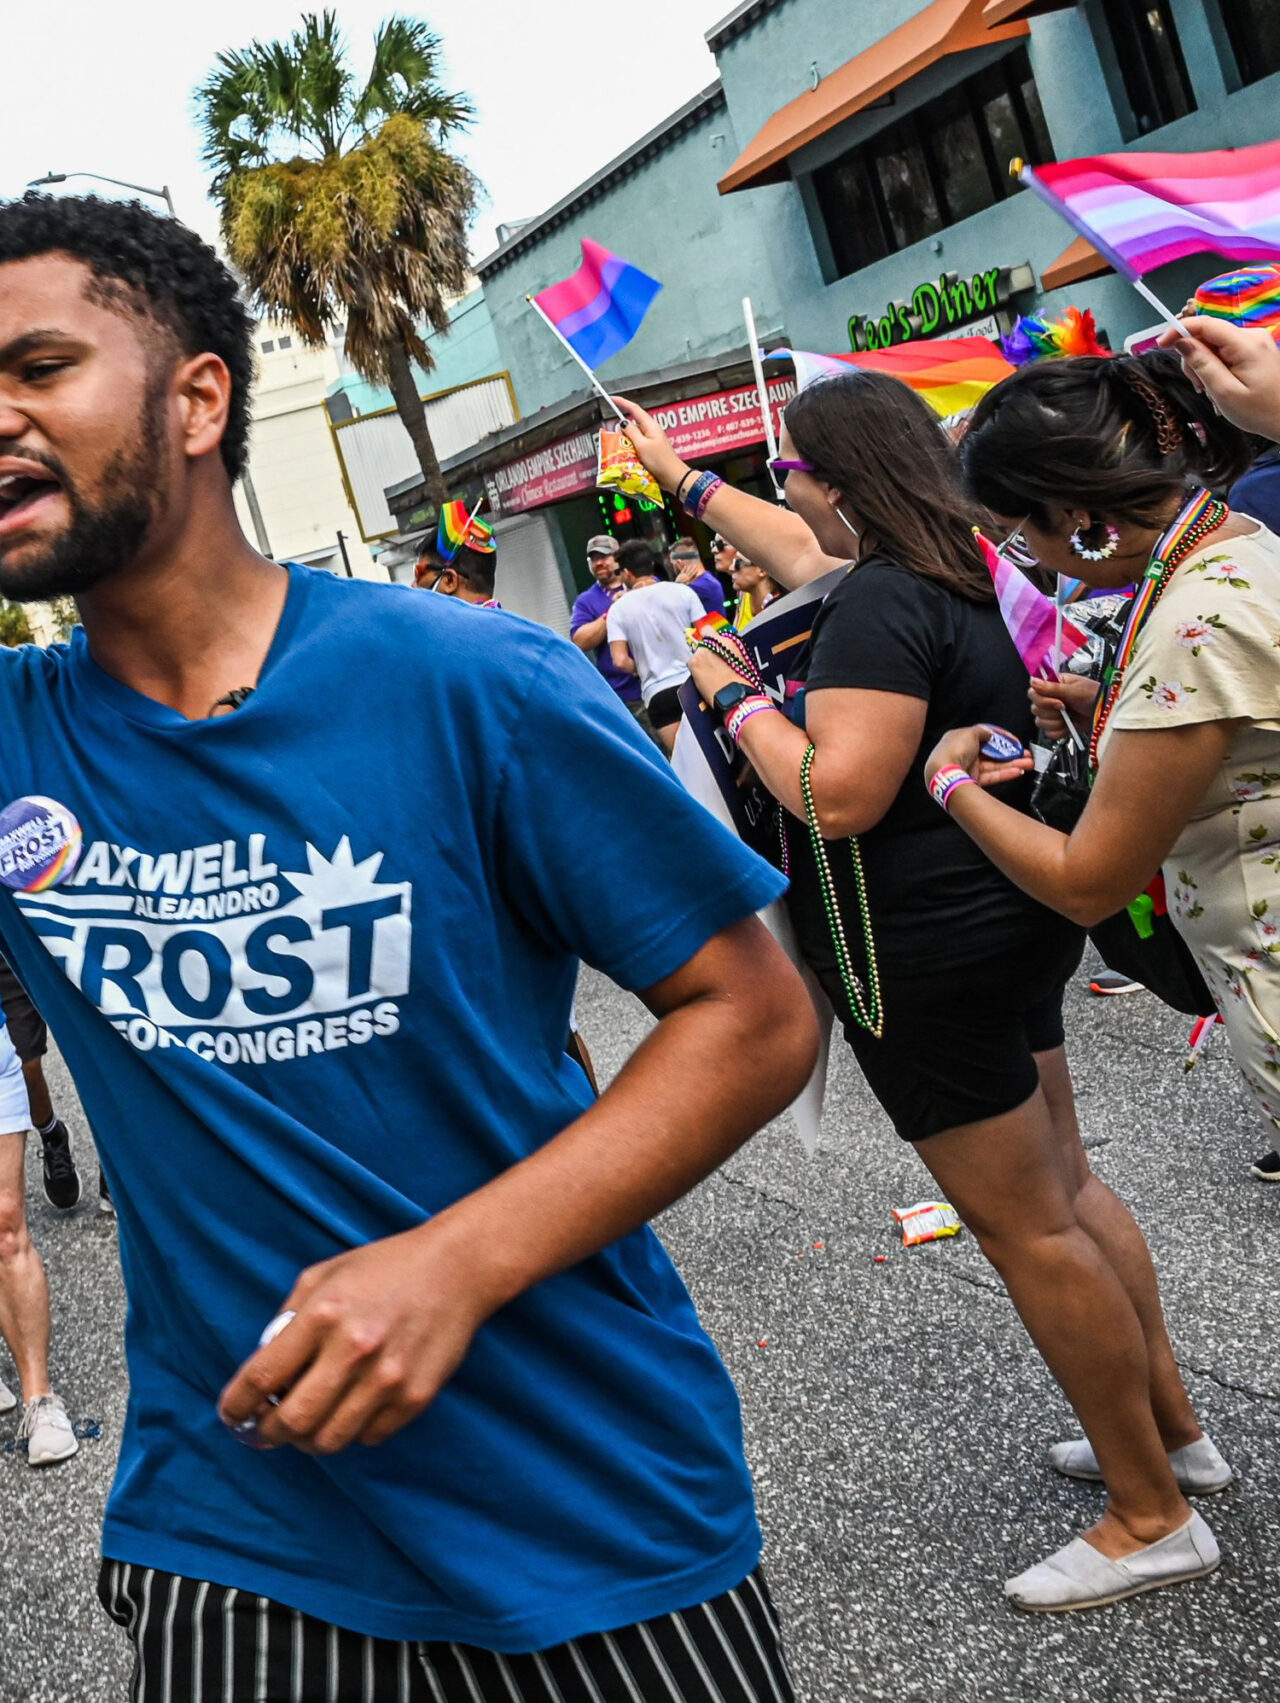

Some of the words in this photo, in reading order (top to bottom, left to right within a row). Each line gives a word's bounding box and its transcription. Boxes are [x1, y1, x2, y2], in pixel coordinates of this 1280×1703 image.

[912, 267, 1001, 334] Diner
[678, 397, 730, 427] EMPIRE
[728, 381, 797, 413] SZECAUN
[495, 460, 529, 493] ORLANDO
[526, 448, 556, 481] EMPIRE
[0, 821, 65, 873] FROST
[61, 833, 278, 896] AXWELL
[133, 882, 280, 920] ALEJANDRO
[185, 1001, 400, 1064] CONGRESS
